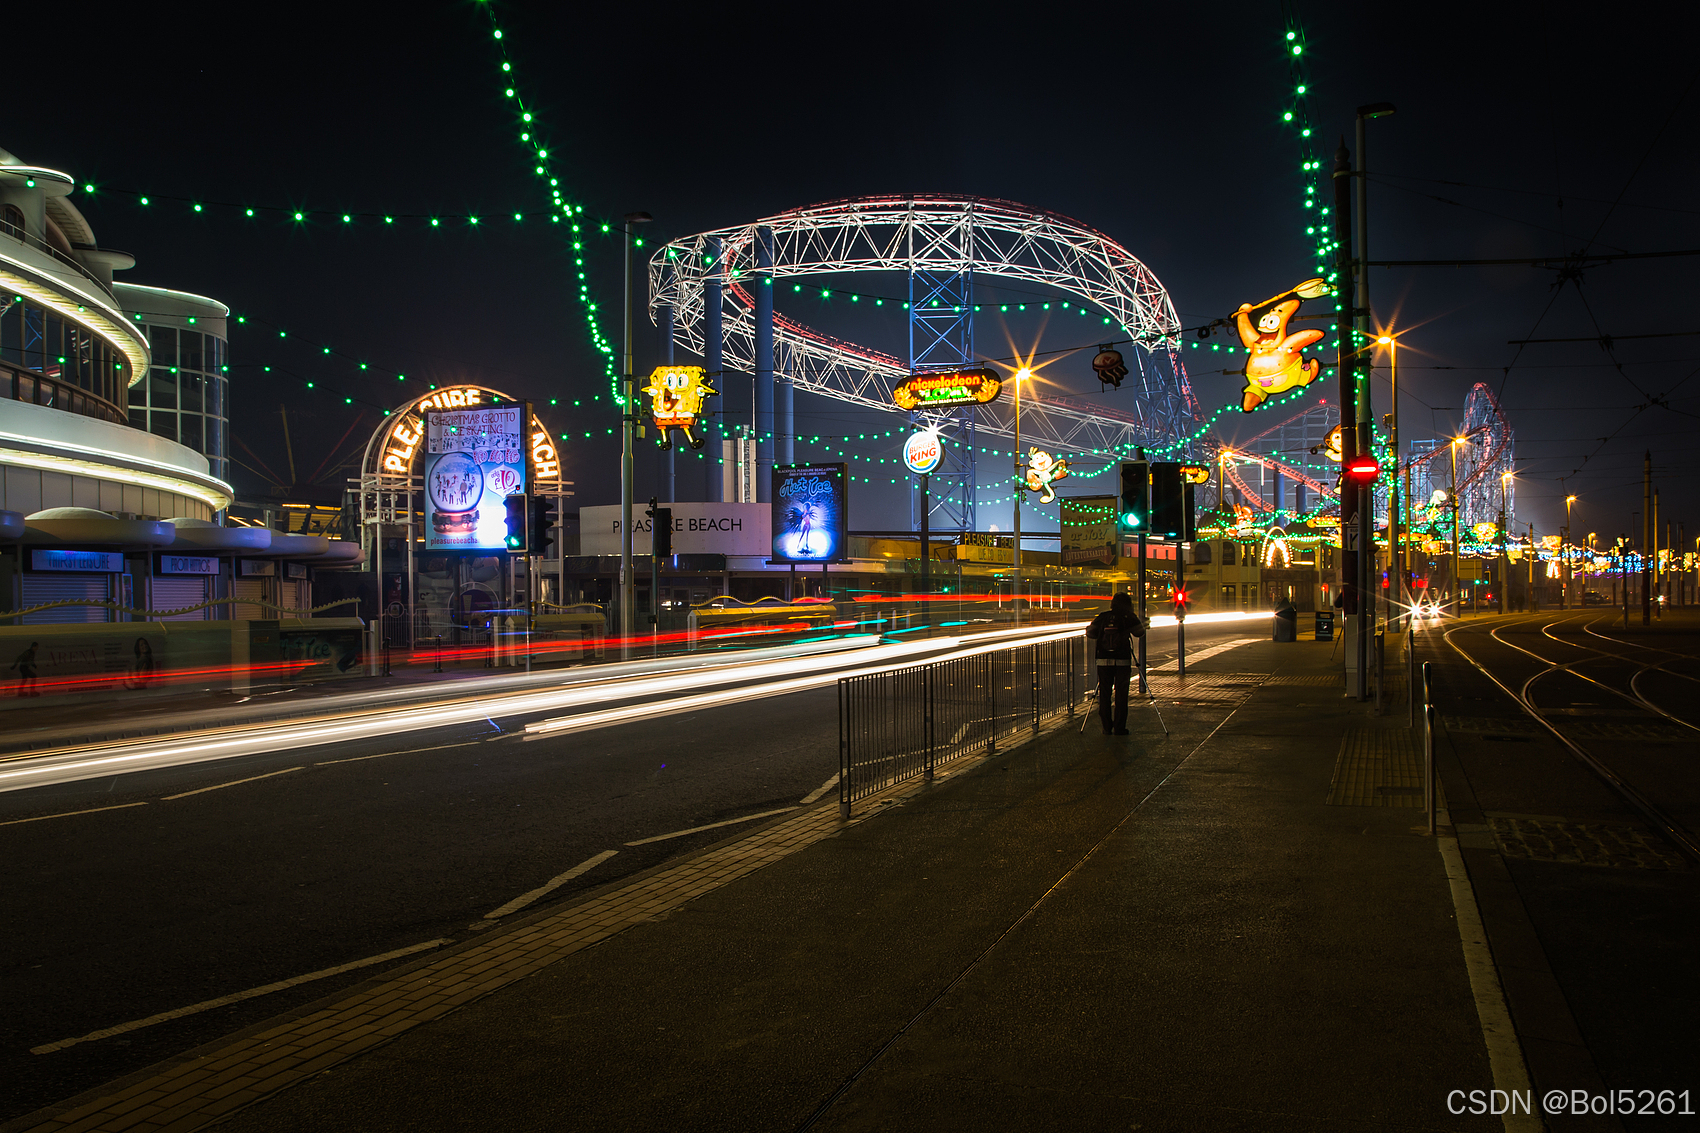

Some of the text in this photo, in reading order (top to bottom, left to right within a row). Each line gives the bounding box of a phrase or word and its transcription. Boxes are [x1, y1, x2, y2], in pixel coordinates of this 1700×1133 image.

[909, 374, 981, 391] nickelodeon
[431, 411, 516, 427] CHRISTMAS GROTTO
[466, 424, 503, 436] SKATING
[909, 440, 937, 463] BURGER KING
[689, 518, 742, 532] BEACH
[1069, 532, 1082, 541] or
